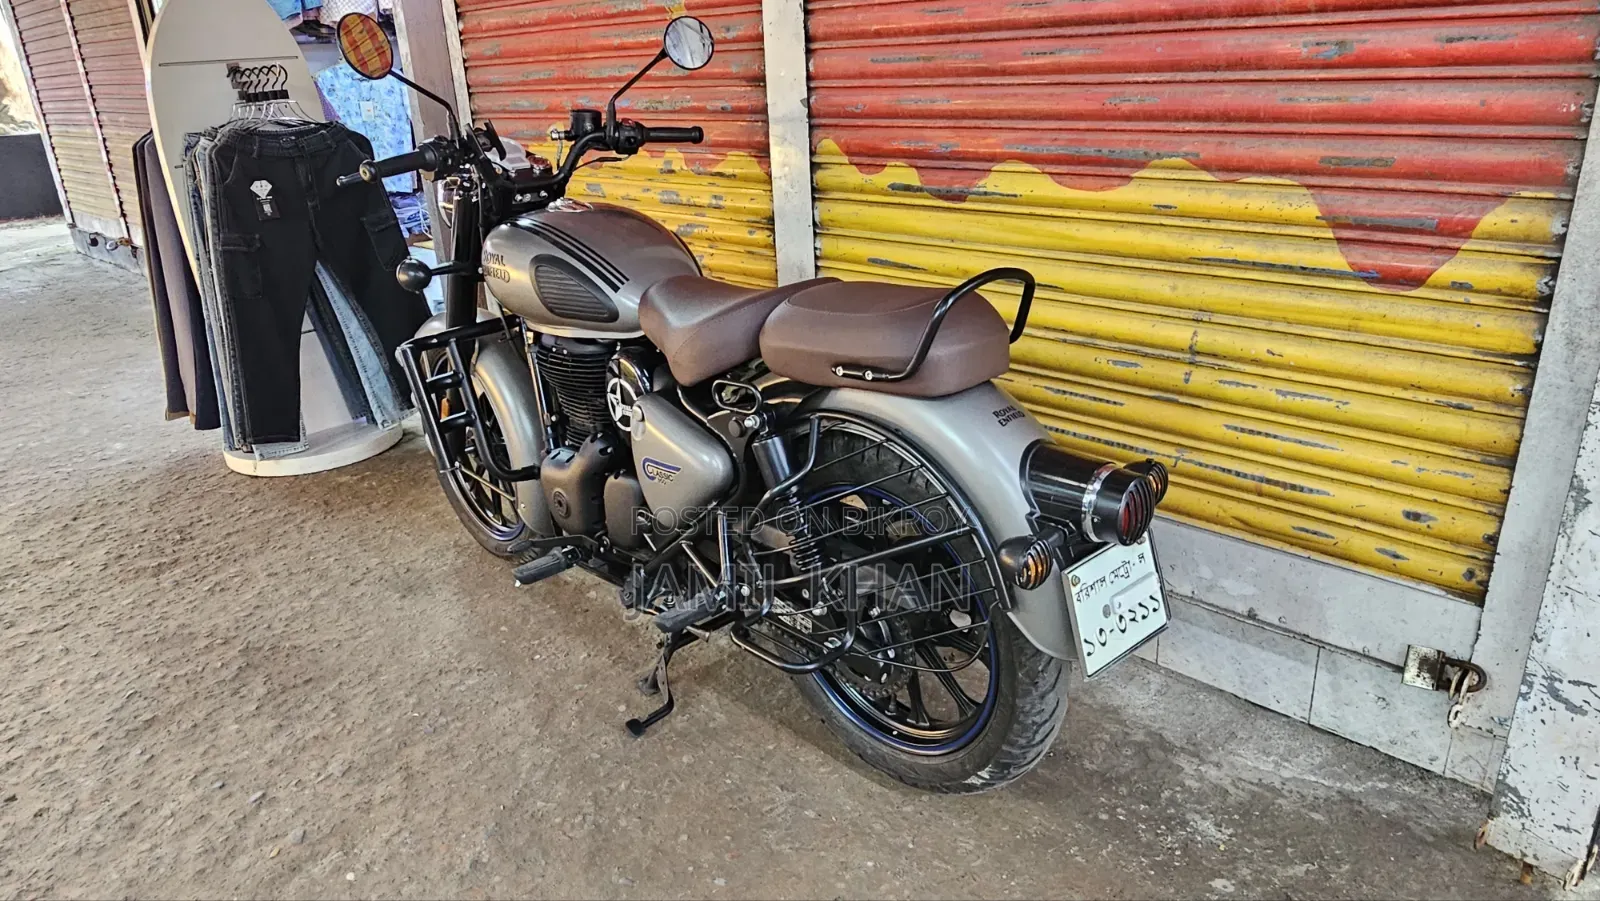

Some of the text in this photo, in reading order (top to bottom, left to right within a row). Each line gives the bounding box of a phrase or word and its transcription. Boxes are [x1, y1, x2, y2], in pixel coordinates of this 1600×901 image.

[992, 405, 1017, 418] ROYAL
[998, 410, 1026, 427] ENFIELD
[646, 463, 674, 482] CLASSIC
[1074, 577, 1107, 603] বরিশাল
[1083, 595, 1161, 657] ১৩-৩২১১
